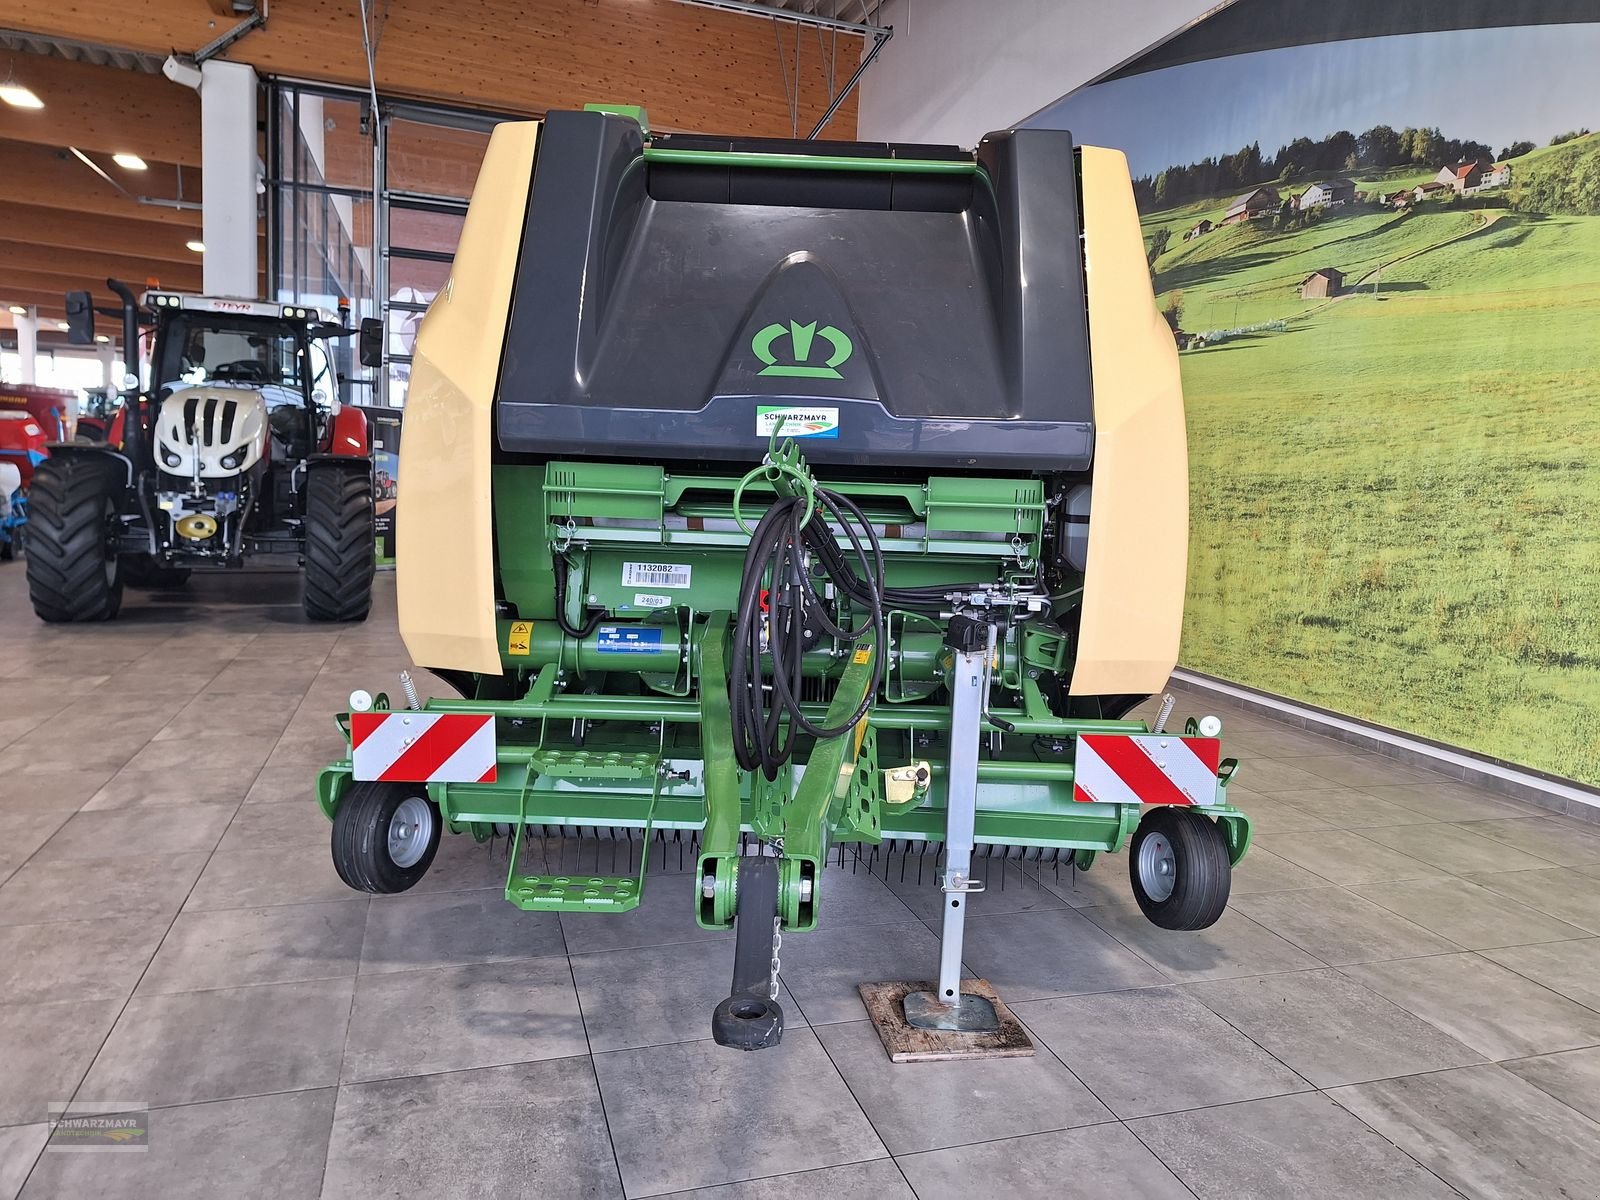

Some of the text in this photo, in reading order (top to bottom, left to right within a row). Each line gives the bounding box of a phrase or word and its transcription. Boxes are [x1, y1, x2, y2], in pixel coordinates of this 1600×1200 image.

[213, 301, 251, 310] STEYR
[764, 413, 827, 421] SCHWARZMAYR
[637, 564, 673, 572] 1132082
